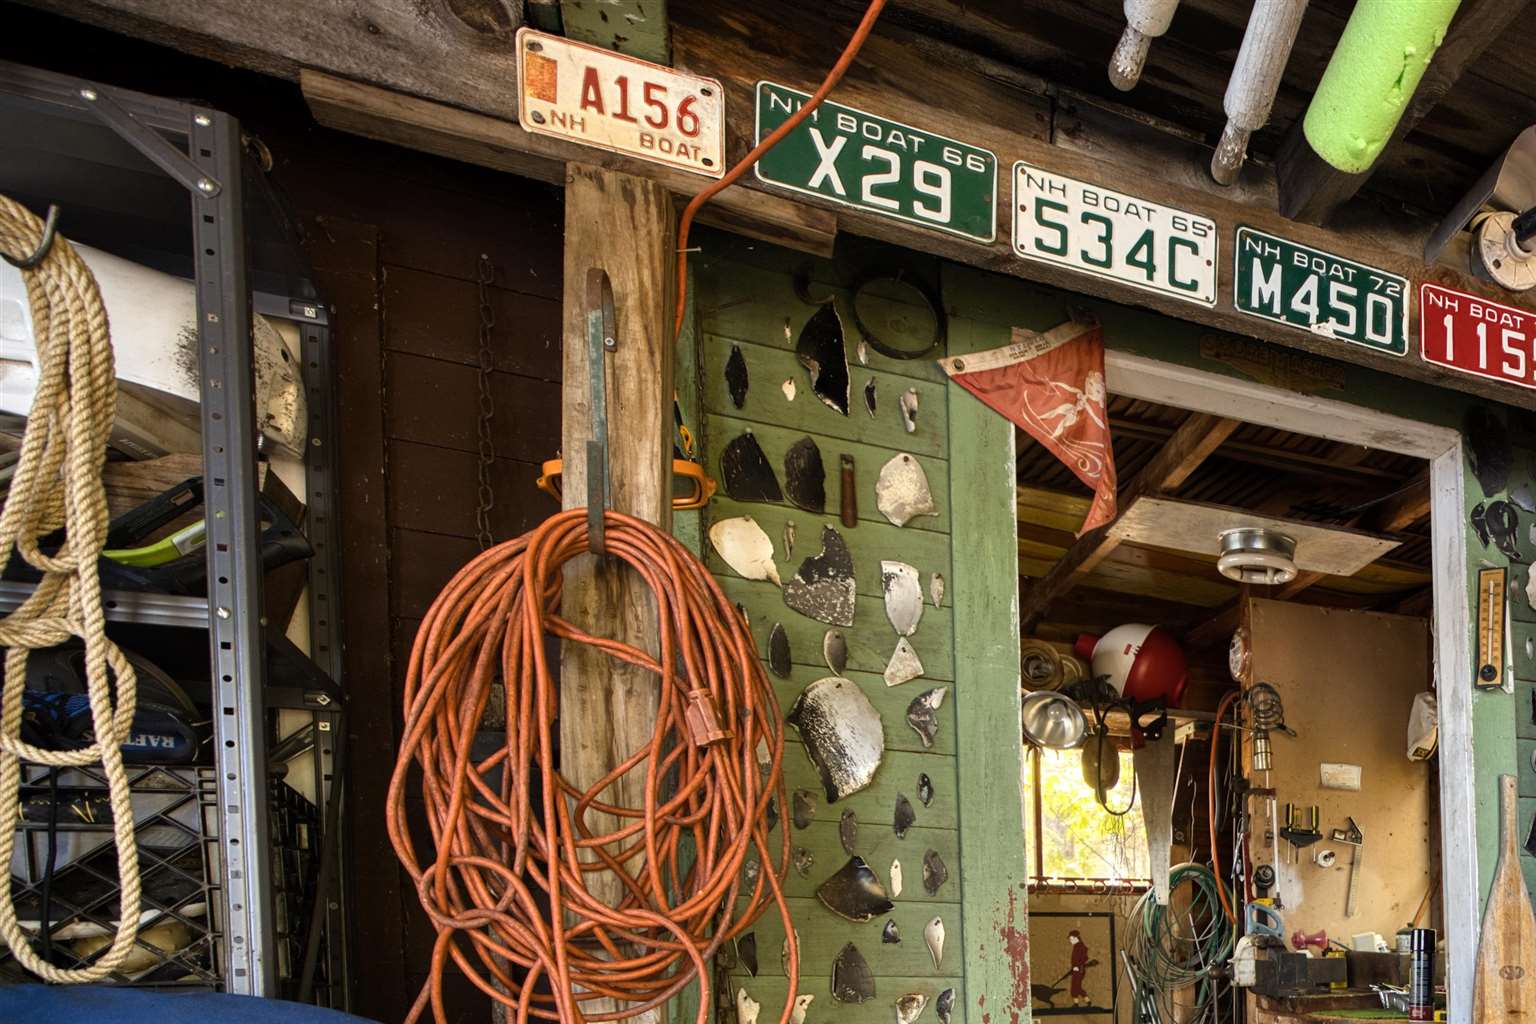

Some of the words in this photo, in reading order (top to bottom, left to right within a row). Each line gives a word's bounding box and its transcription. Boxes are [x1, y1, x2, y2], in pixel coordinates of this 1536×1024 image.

[580, 66, 700, 138] A156
[549, 111, 587, 134] NH
[639, 132, 702, 161] BOAT
[837, 112, 925, 154] BOAT
[942, 145, 986, 173] 66
[808, 127, 952, 224] X29
[1026, 172, 1066, 198] NH
[1082, 189, 1157, 223] BOAT
[1172, 215, 1208, 238] 65
[1034, 197, 1200, 292] 534C
[1245, 237, 1281, 261] NH
[1293, 251, 1357, 284] BOAT
[1370, 276, 1401, 297] 72
[1250, 258, 1393, 346] M450
[1429, 291, 1459, 313] NH
[1469, 304, 1524, 331] BOAT
